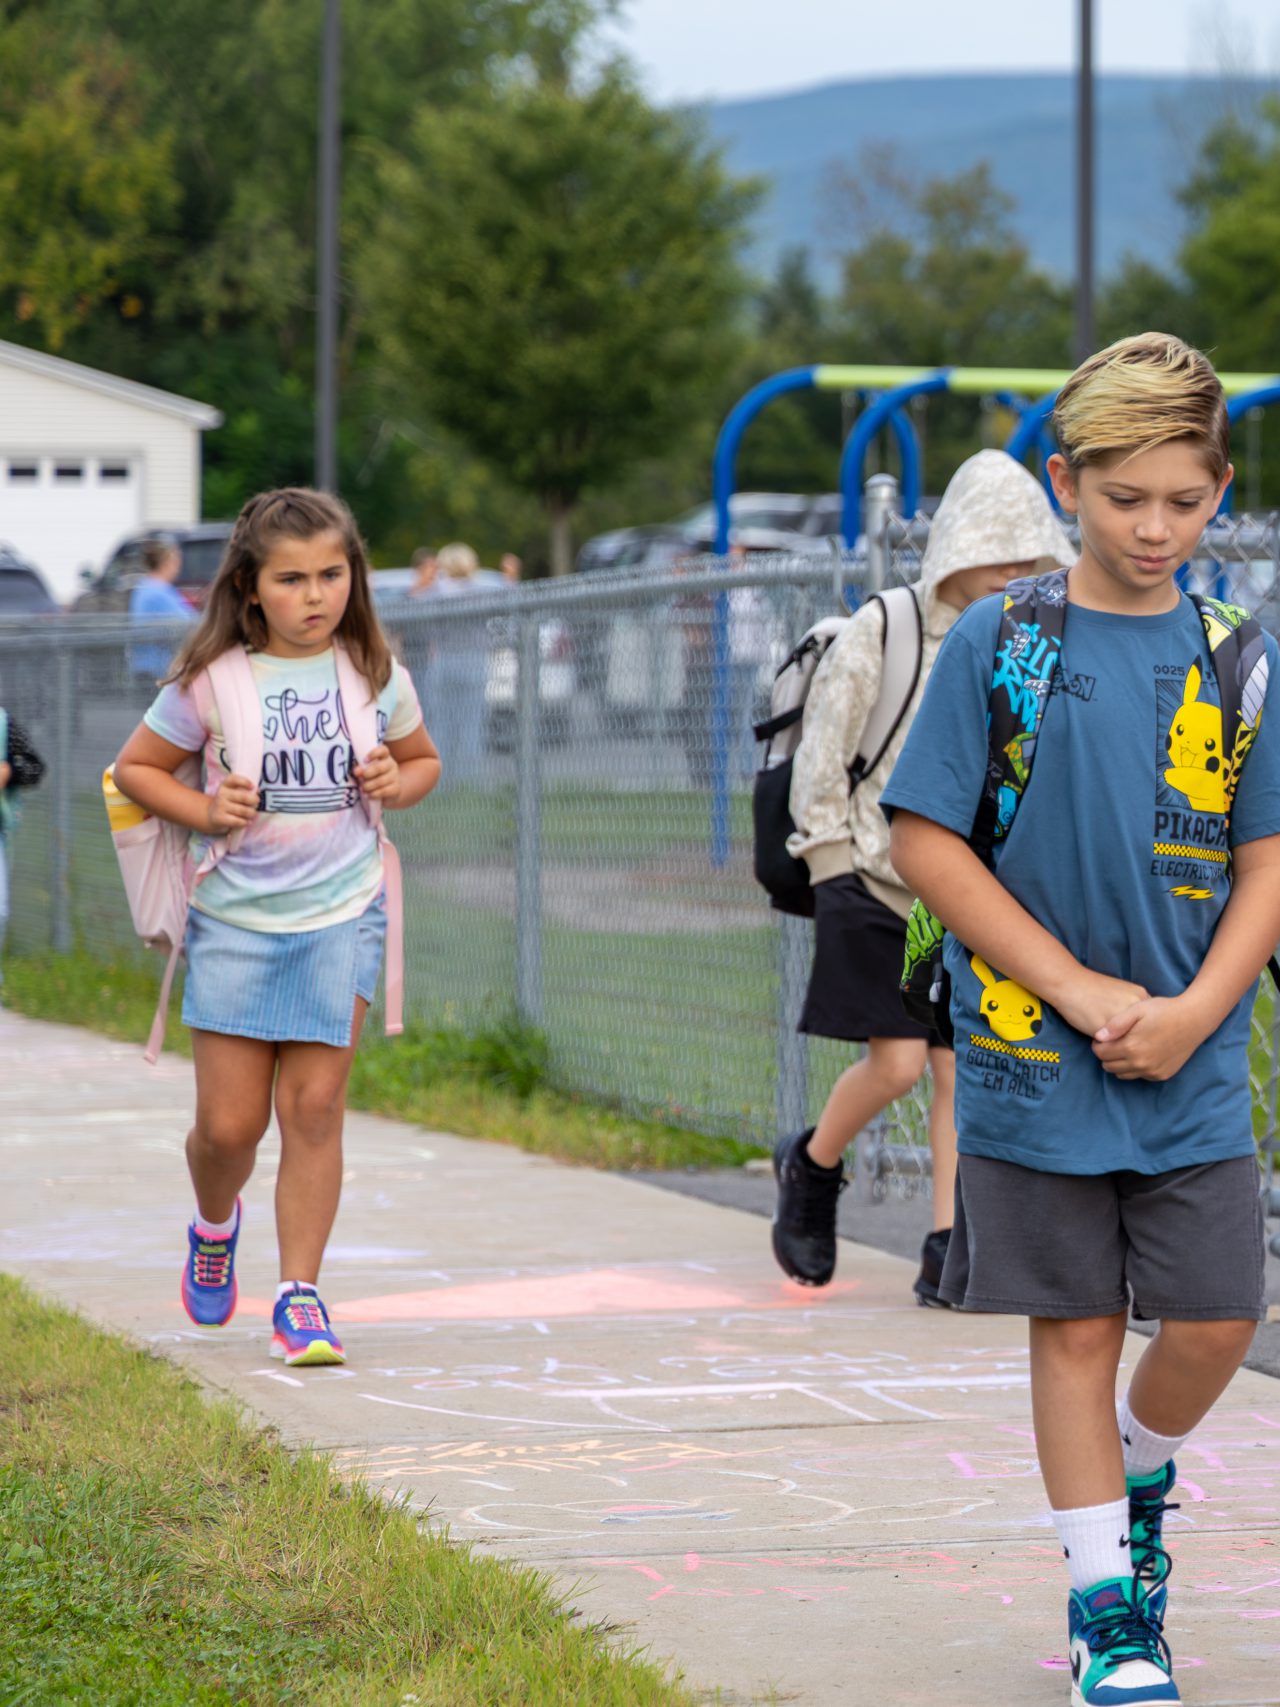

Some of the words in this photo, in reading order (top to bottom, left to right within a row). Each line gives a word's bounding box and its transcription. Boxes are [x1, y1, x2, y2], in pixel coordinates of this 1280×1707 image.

[1153, 664, 1185, 676] 0025
[1154, 810, 1226, 847] PIKACH
[1150, 859, 1210, 880] ELECTRIC
[966, 1048, 1010, 1073] GOTTA
[1013, 1061, 1060, 1083] CATCH
